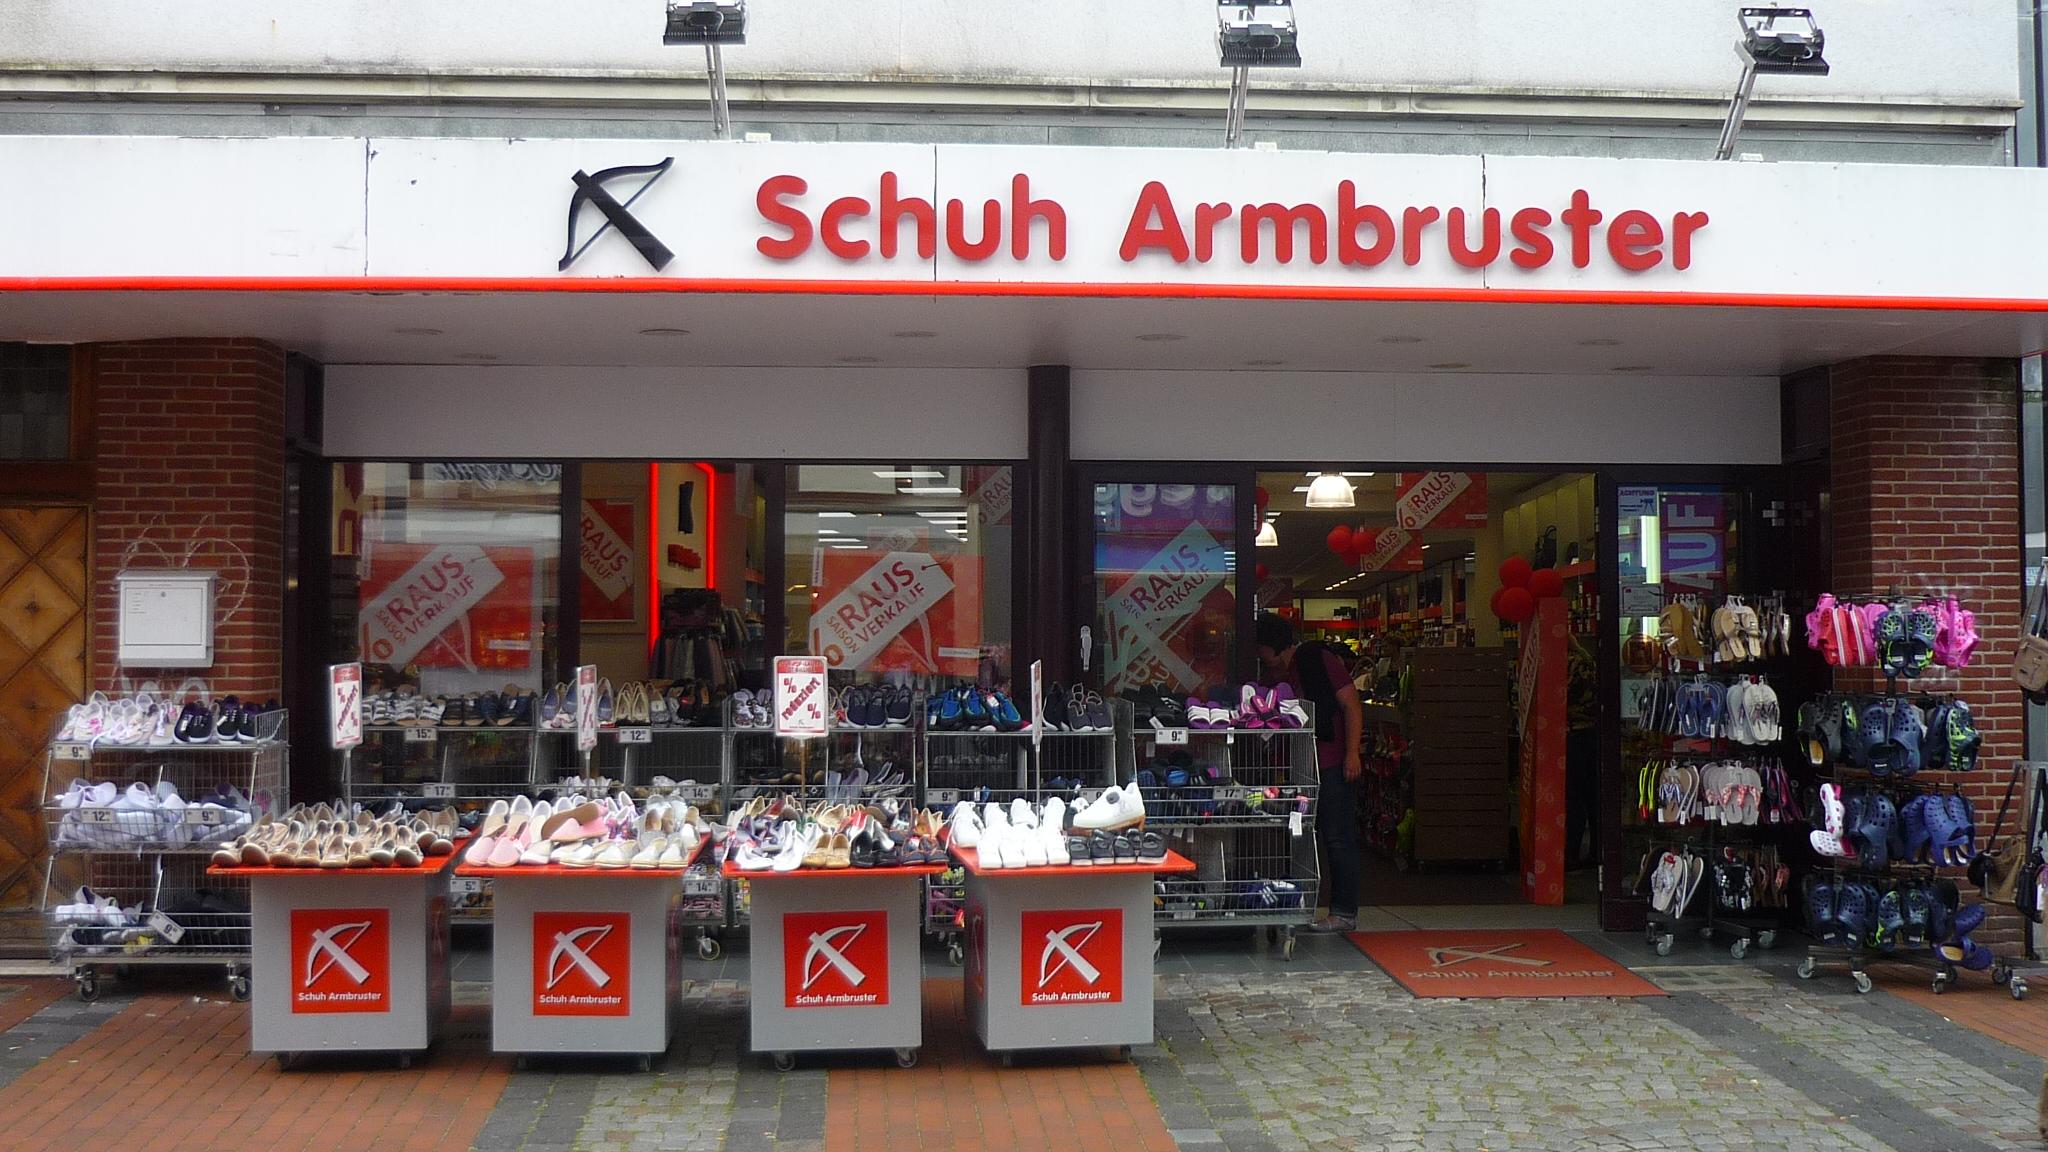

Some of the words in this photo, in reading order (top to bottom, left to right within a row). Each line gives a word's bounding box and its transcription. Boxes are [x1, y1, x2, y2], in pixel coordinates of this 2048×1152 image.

[756, 171, 1067, 262] Schuh
[1119, 179, 1709, 271] Armbruster
[1411, 472, 1451, 509] RAUS
[1420, 481, 1457, 514] VERKAUF
[581, 518, 628, 572] RAUS
[386, 554, 465, 625] RAUS
[837, 560, 915, 631] RAUS
[1129, 544, 1200, 612] RAUS
[405, 575, 475, 636] VERKAUF
[856, 583, 925, 643] VERKAUF
[826, 615, 859, 654] SAISON
[781, 676, 821, 720] reduziert
[783, 677, 797, 693] %
[808, 703, 821, 719] %
[1407, 970, 1480, 980] Schuh
[1487, 969, 1615, 979] Armbruster
[298, 991, 326, 1002] Schuh
[328, 991, 382, 1002] Armbruster
[539, 995, 567, 1004] Schuh
[569, 994, 622, 1005] Armbruster
[795, 993, 823, 1004] Schuh
[825, 992, 878, 1003] Armbruster
[1032, 991, 1059, 1001] Schuh
[1060, 990, 1111, 1001] Armbruster
